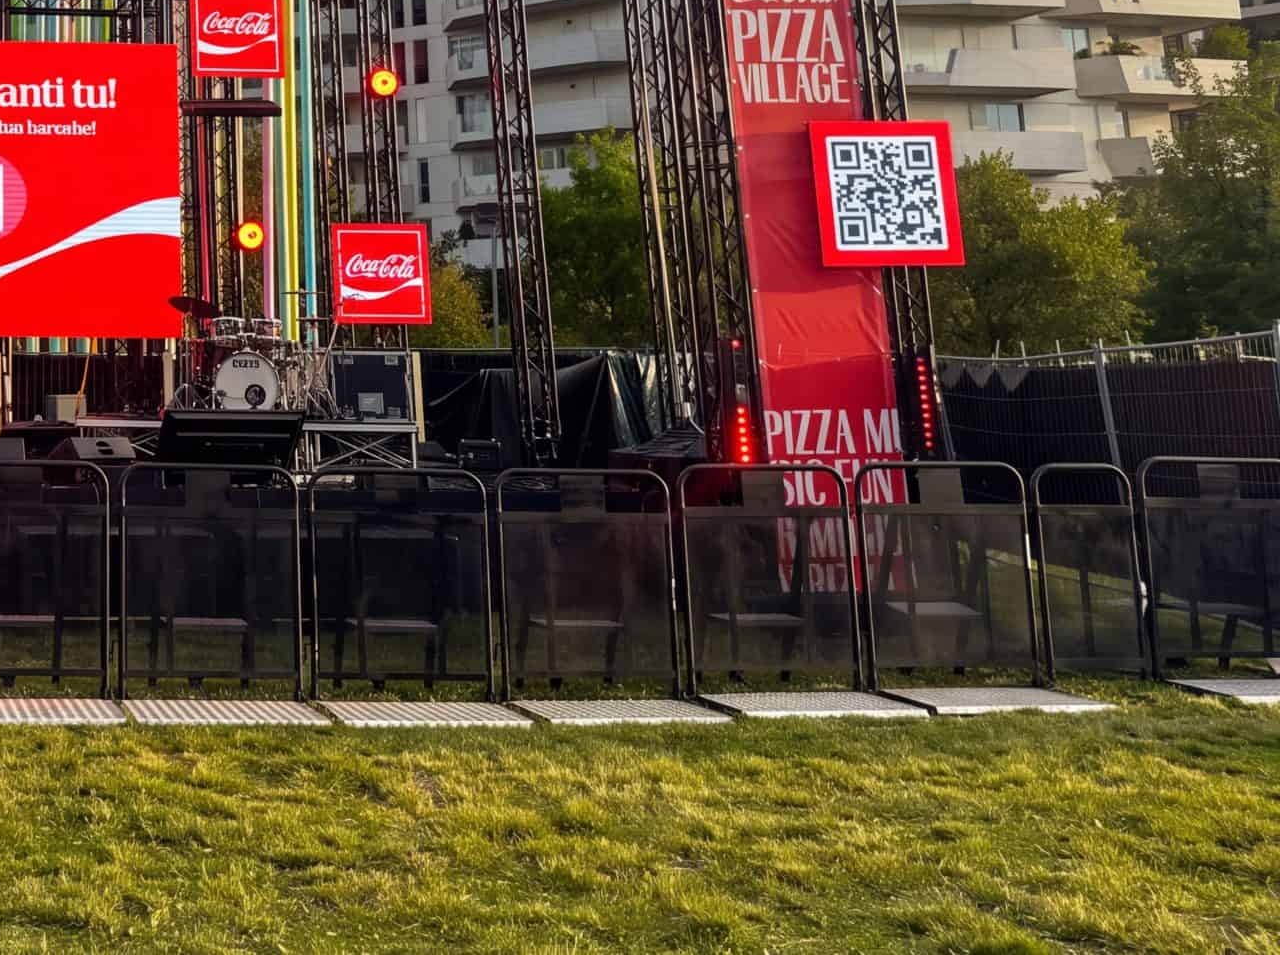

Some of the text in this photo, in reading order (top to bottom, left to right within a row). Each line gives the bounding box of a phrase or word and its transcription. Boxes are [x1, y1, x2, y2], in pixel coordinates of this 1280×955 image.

[203, 11, 272, 35] Coca-Cola
[729, 8, 845, 62] PIZZA
[72, 78, 117, 108] tu!
[737, 63, 851, 104] VILLAGE
[345, 253, 417, 278] Coca-Cola
[763, 409, 856, 455] PIZZA
